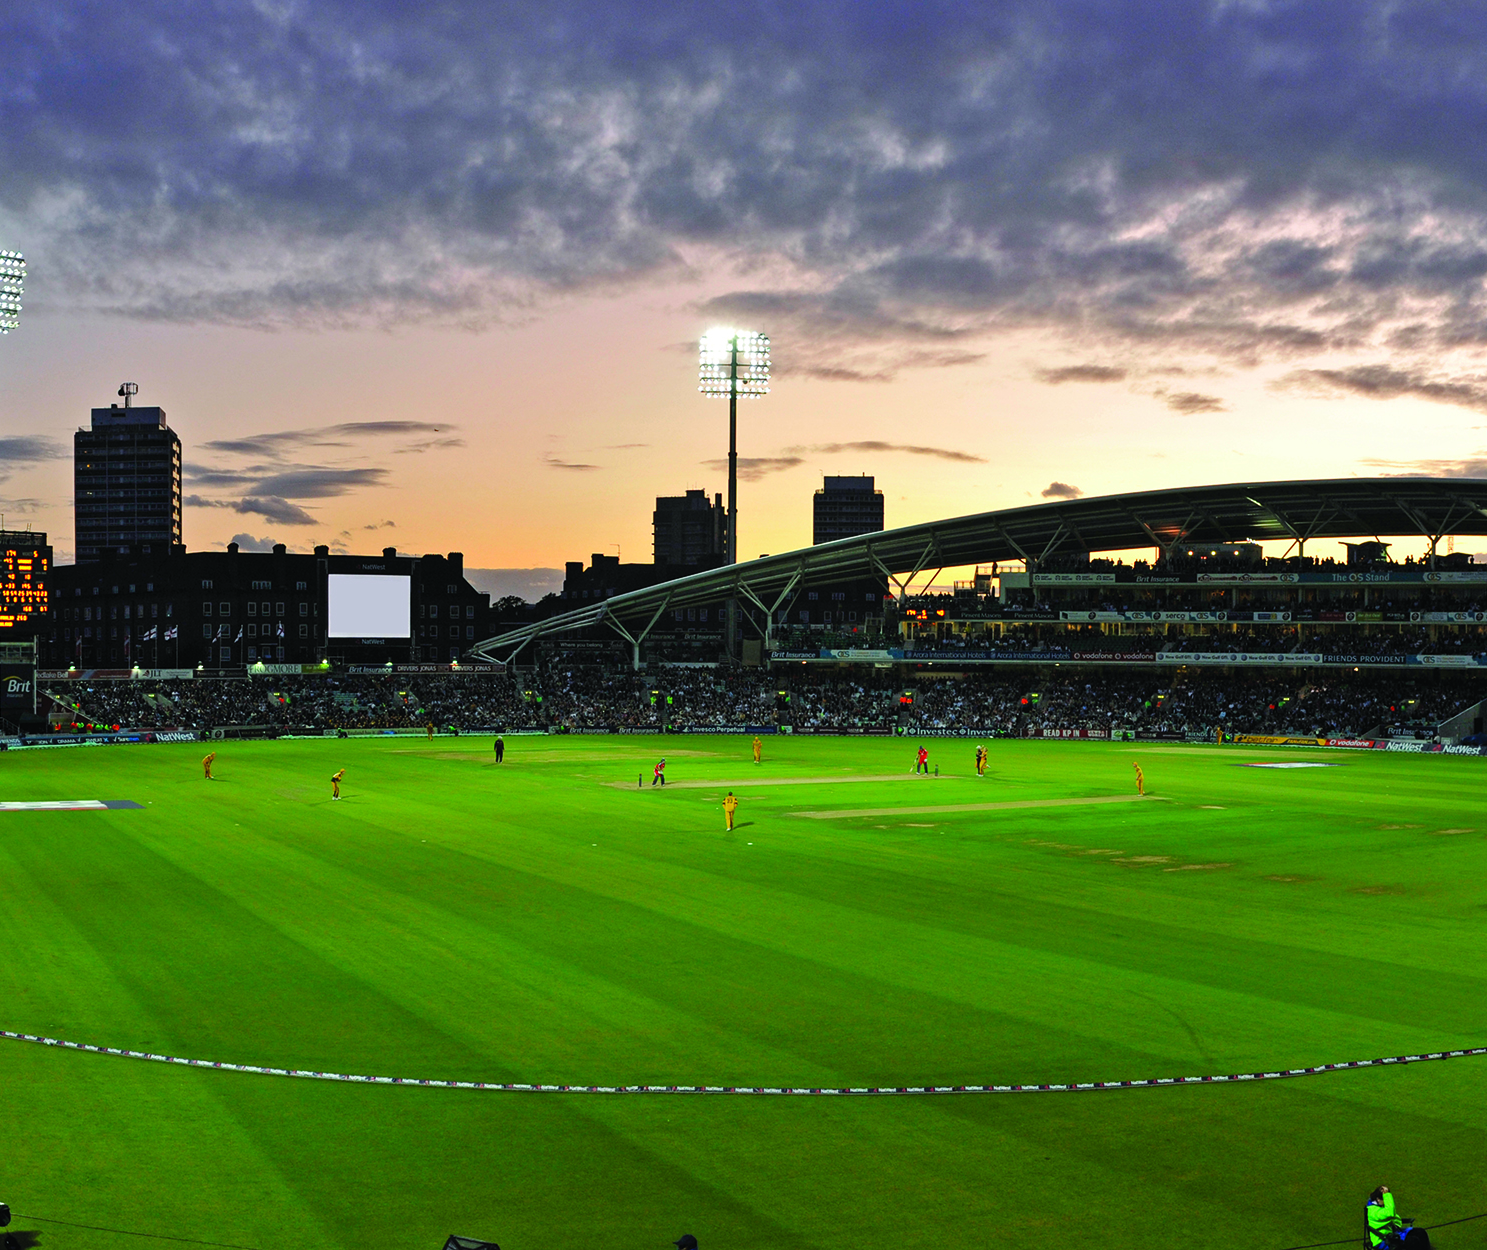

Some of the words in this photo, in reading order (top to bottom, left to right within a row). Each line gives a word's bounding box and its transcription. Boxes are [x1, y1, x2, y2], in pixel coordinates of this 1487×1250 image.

[1360, 655, 1405, 663] PROVIDENT
[7, 680, 31, 692] Brit
[156, 732, 196, 741] NatWest
[1385, 741, 1423, 752] NatWest
[1442, 745, 1481, 754] NatWest
